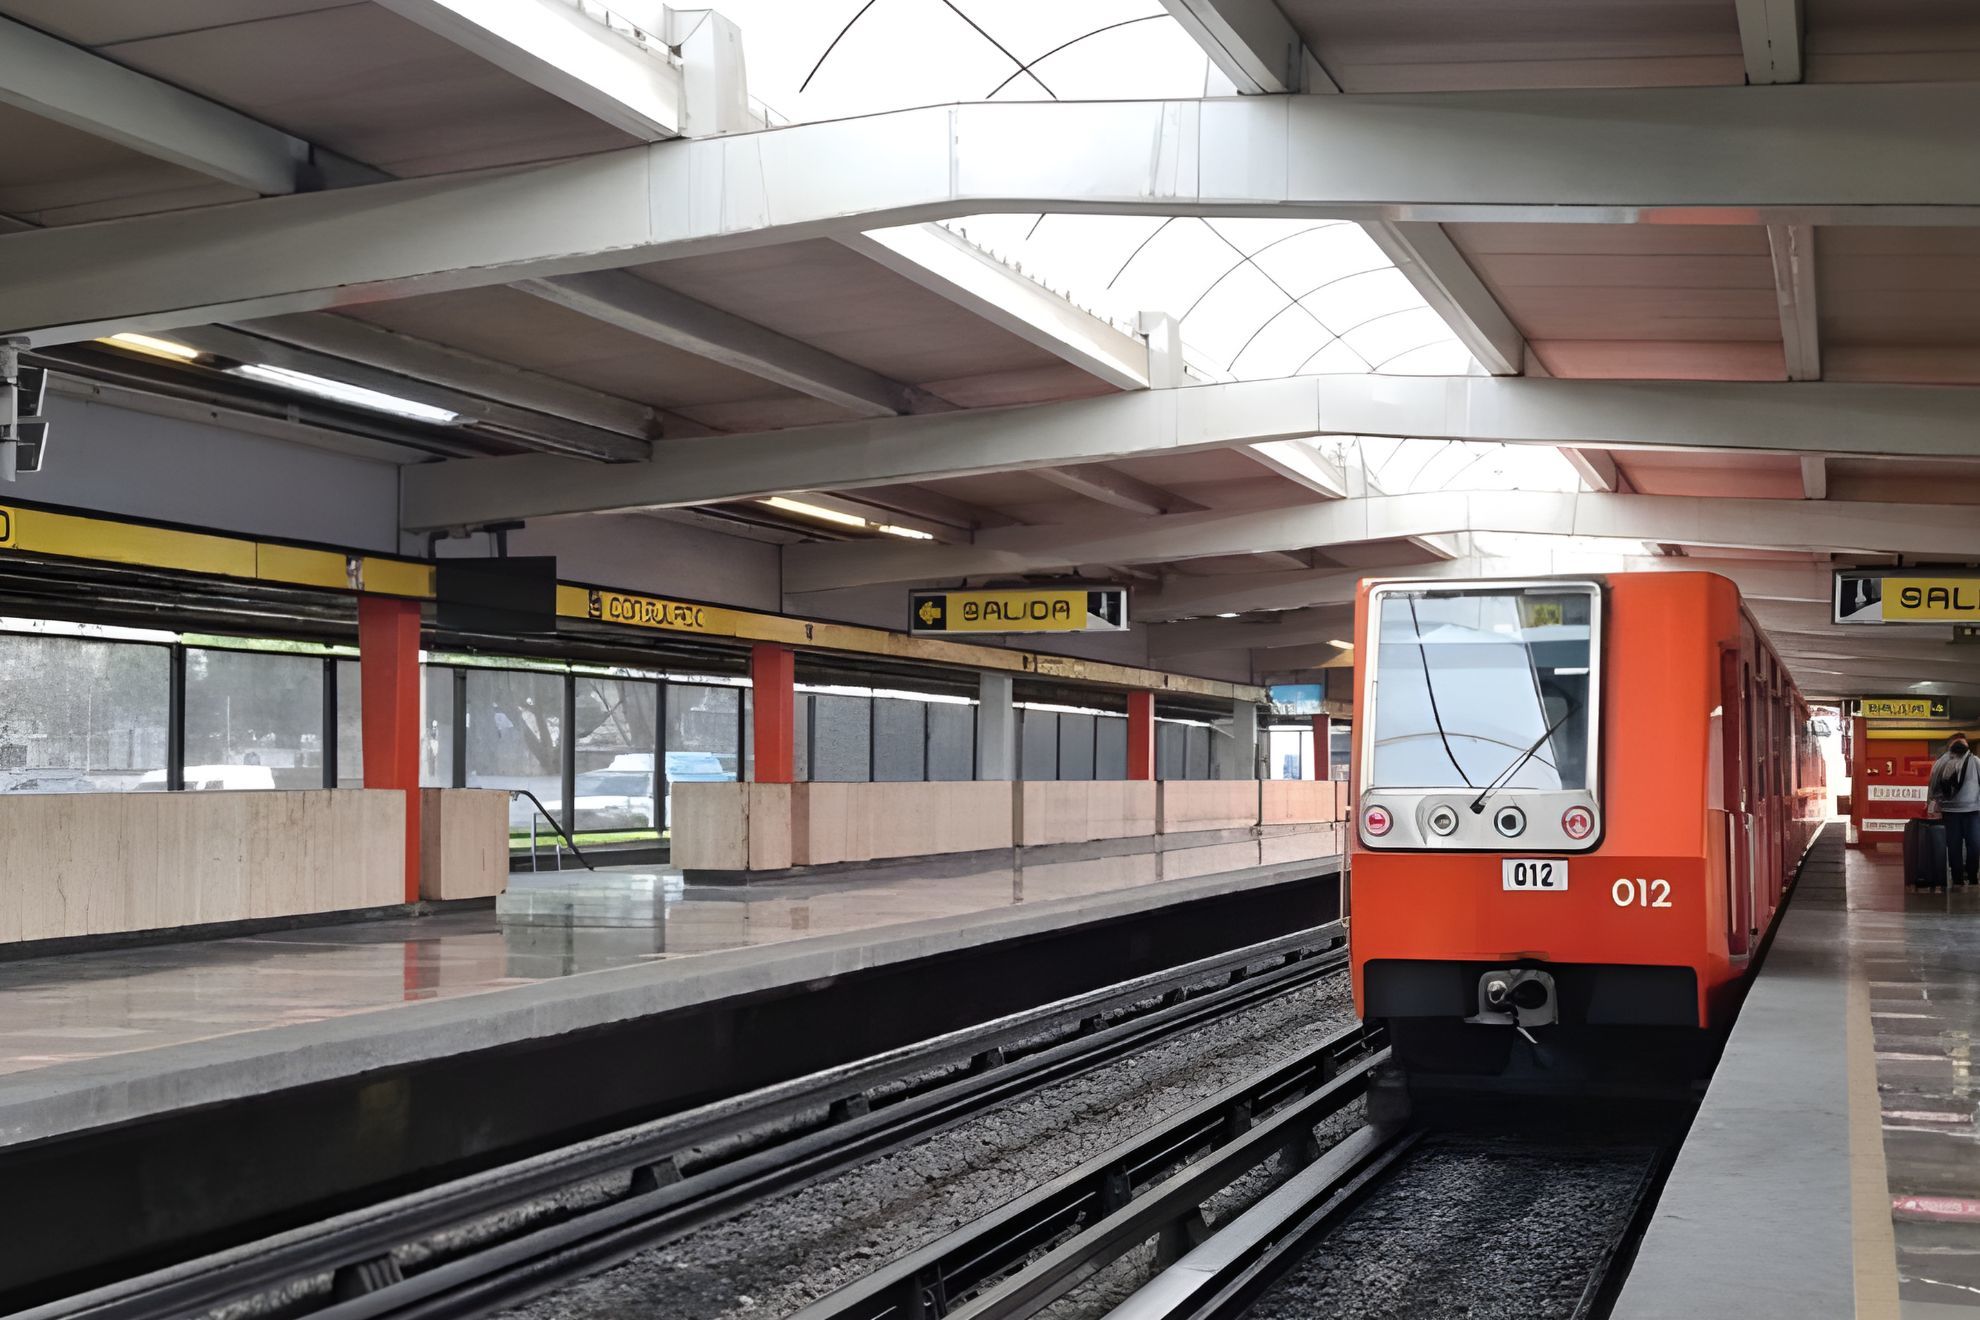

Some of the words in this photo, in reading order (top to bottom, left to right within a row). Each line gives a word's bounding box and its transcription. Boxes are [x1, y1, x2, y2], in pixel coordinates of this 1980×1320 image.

[1900, 587, 1980, 610] SAL
[1514, 862, 1554, 887] 012
[1612, 878, 1672, 908] 012
